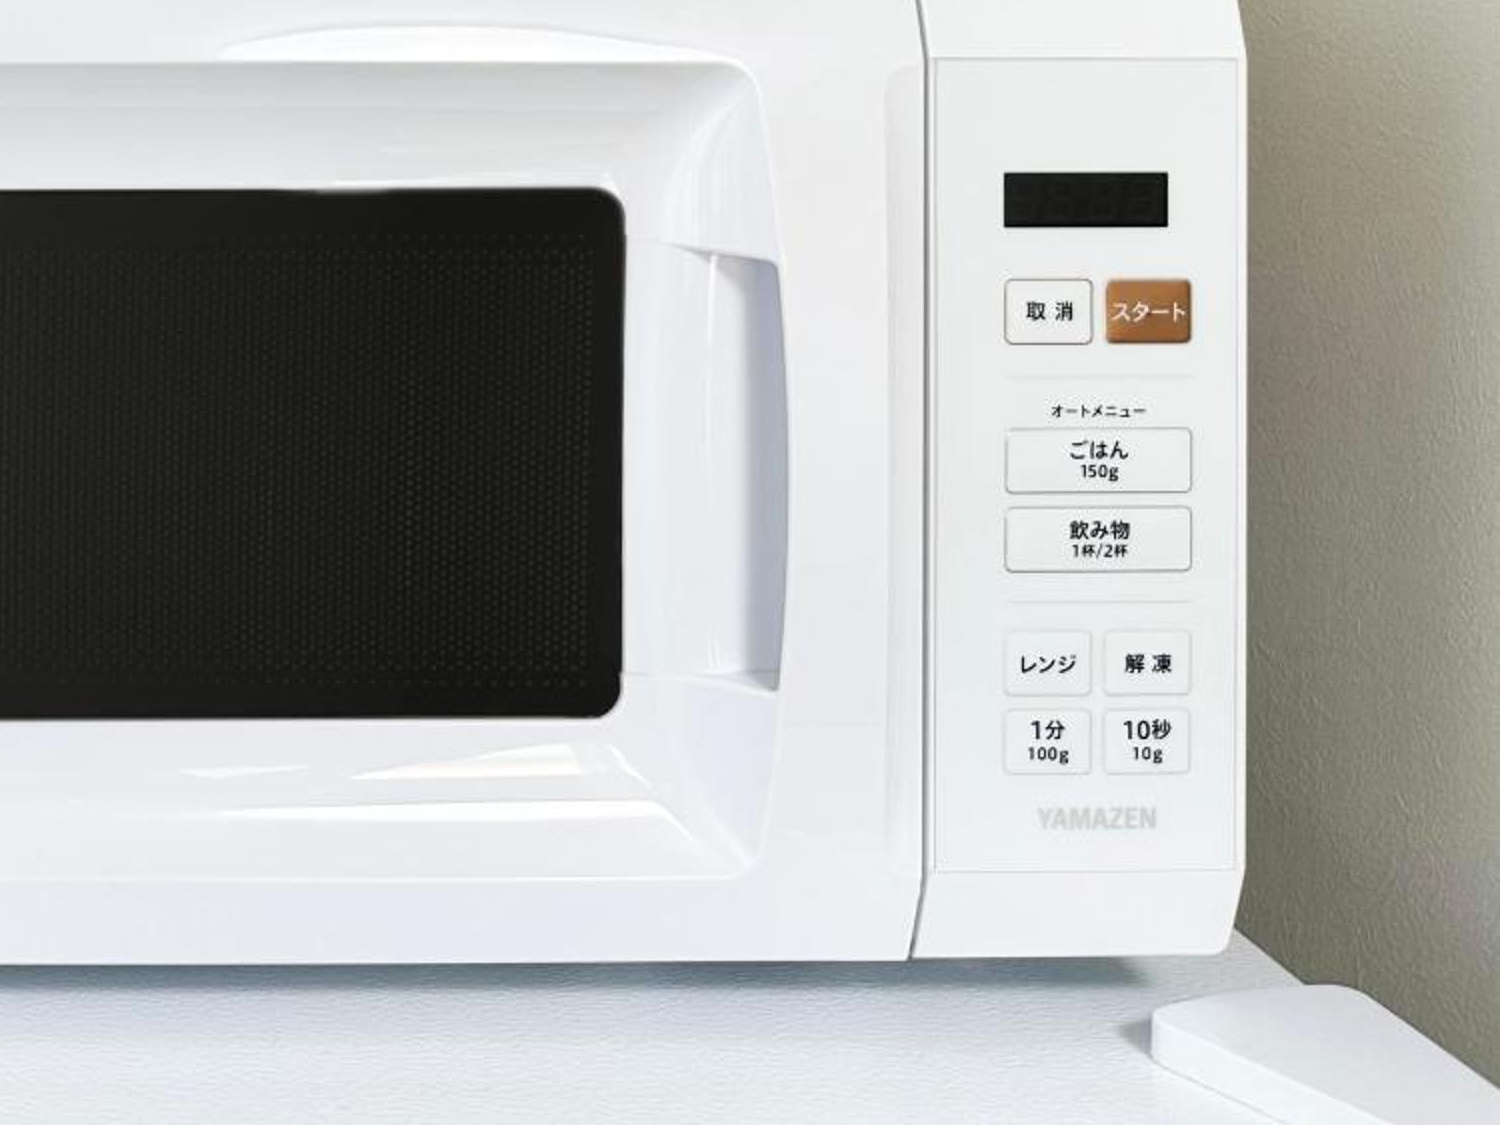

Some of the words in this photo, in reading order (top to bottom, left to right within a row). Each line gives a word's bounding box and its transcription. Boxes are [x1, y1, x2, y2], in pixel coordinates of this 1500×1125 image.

[1025, 301, 1074, 322] 取消
[1111, 302, 1187, 323] スタート
[1050, 404, 1147, 419] オートメニュー
[1069, 440, 1129, 460] ごはん
[1080, 464, 1120, 483] 150g
[1069, 520, 1131, 541] 飲み物
[1072, 544, 1128, 559] 1杯/2杯
[1020, 655, 1077, 674] レンジ
[1124, 653, 1173, 674] 解凍
[1030, 720, 1066, 740] 1分
[1123, 718, 1173, 740] 10秒
[1027, 747, 1070, 765] 100g
[1132, 746, 1164, 764] 10g
[1038, 807, 1157, 830] YAMAZEN
